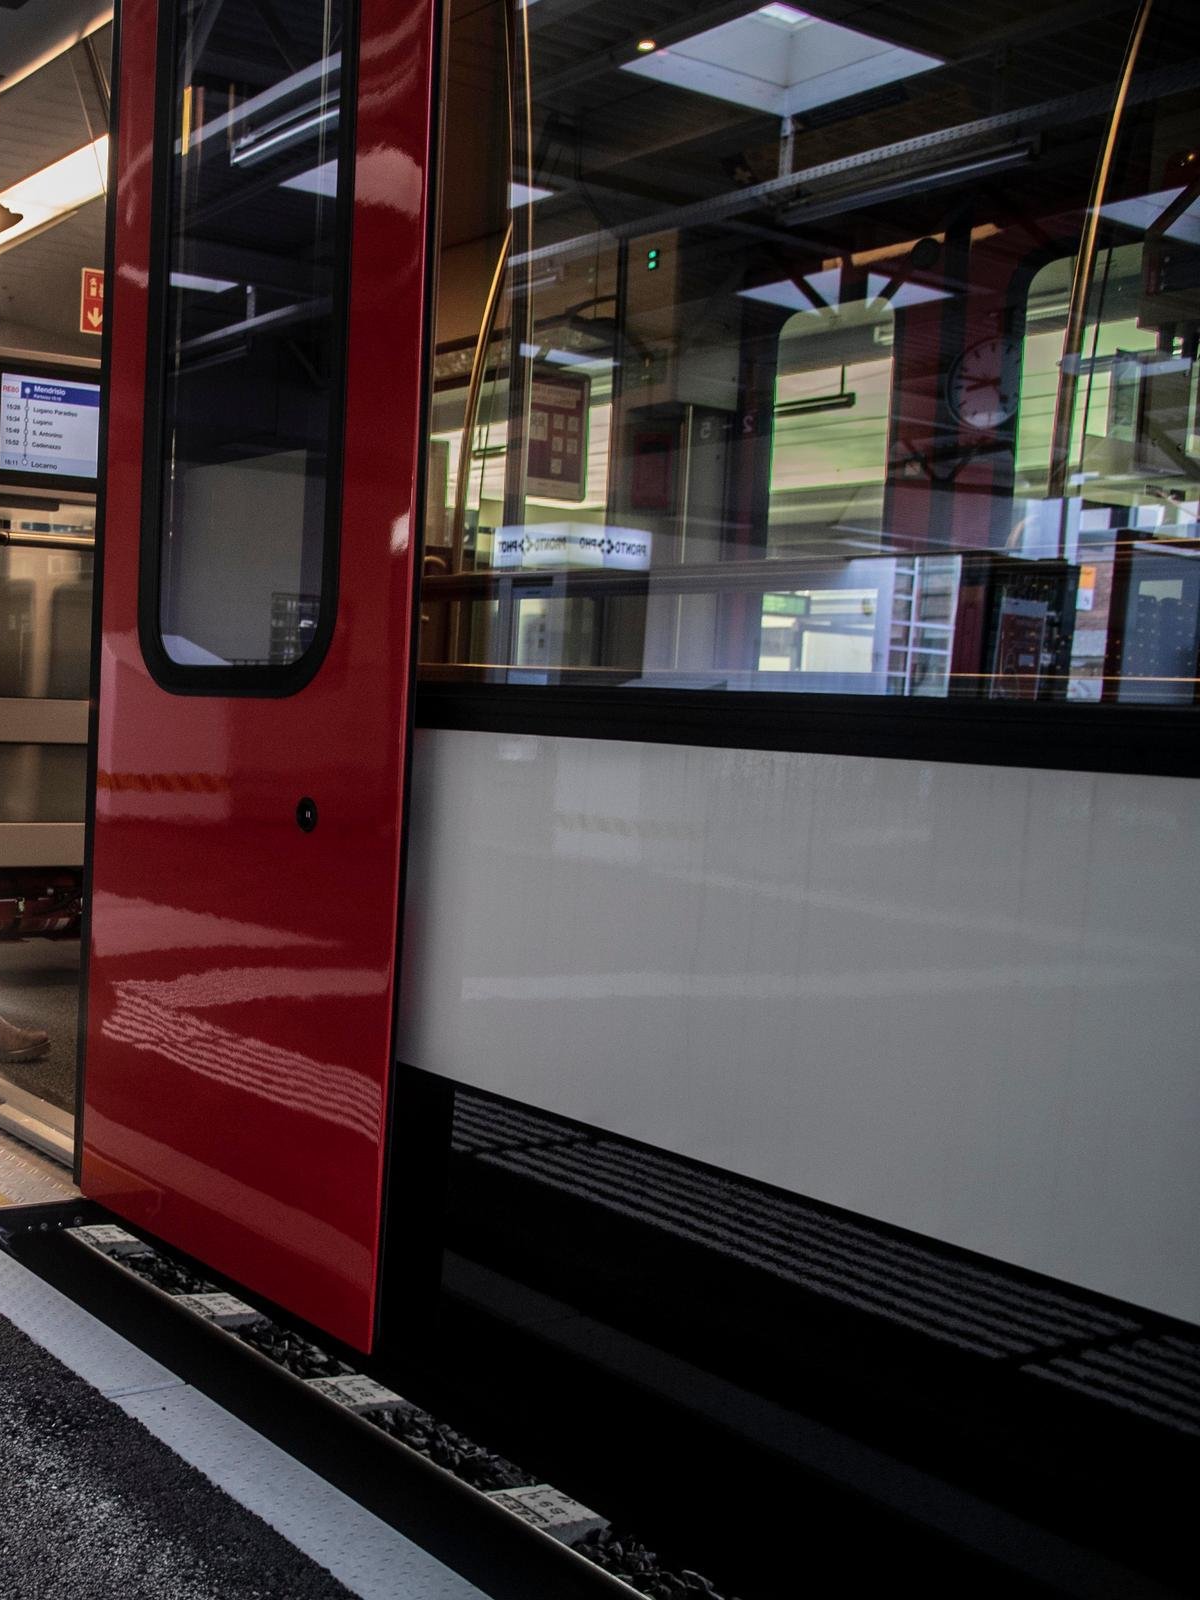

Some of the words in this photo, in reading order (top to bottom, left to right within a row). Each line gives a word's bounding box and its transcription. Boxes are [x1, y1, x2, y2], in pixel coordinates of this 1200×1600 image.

[33, 385, 66, 397] Mendrisio
[32, 418, 53, 427] Lugano
[31, 461, 58, 471] Locarno
